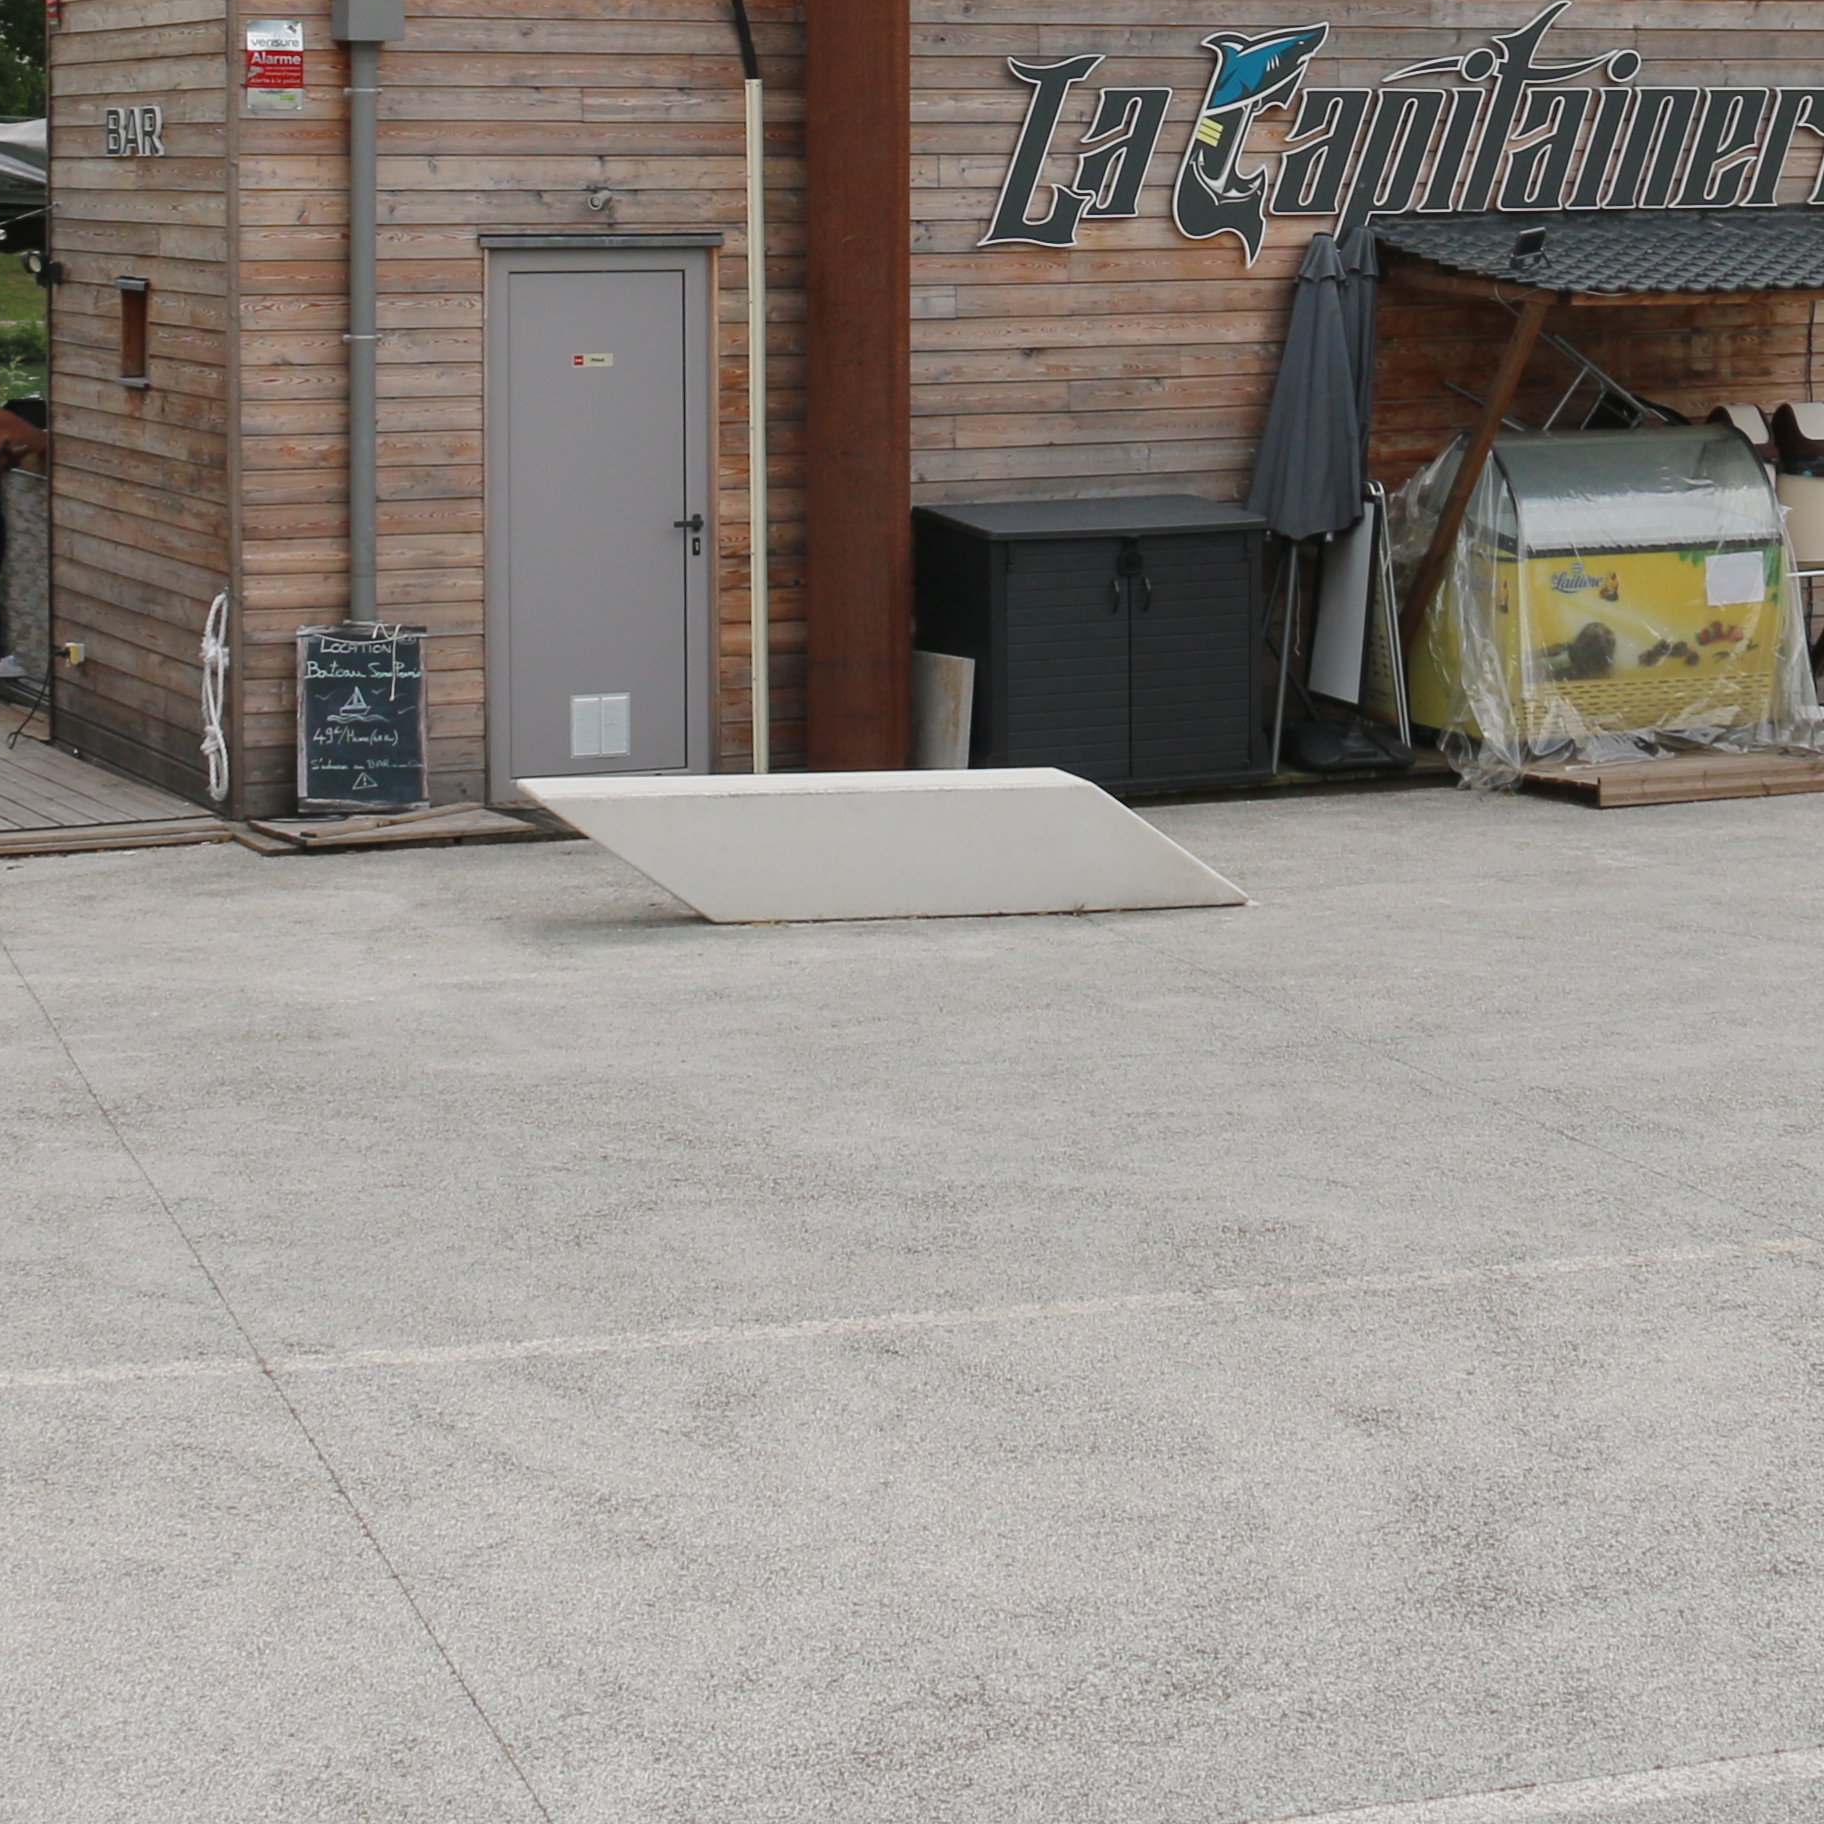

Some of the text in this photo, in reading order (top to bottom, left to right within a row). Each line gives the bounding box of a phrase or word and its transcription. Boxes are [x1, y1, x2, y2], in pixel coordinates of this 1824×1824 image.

[250, 52, 302, 64] Alarme
[106, 104, 164, 157] BAR
[976, 53, 1174, 248] La
[320, 638, 392, 654] LOCATION
